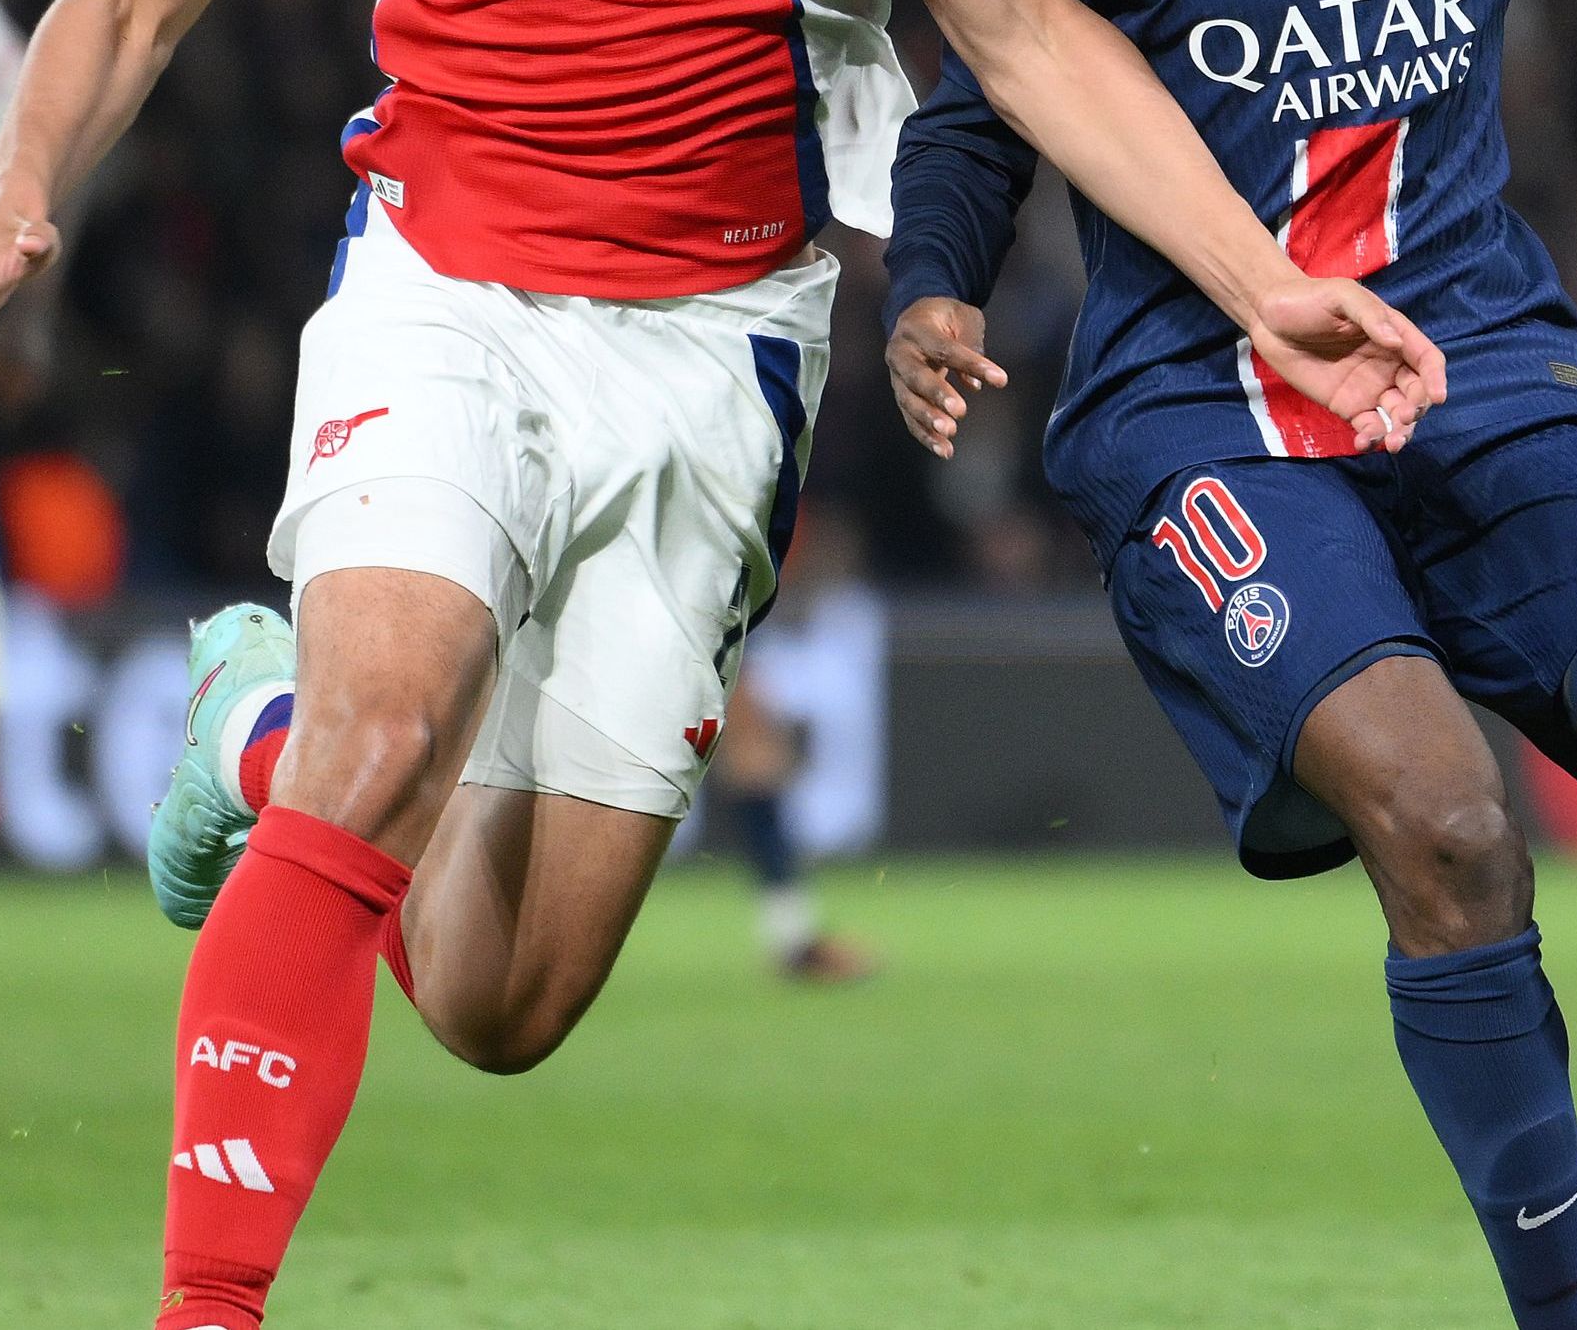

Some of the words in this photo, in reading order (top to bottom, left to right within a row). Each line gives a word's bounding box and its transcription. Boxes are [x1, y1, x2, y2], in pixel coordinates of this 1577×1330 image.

[1272, 42, 1473, 122] AIRWAYS
[724, 220, 785, 244] HEAT.RDY
[1152, 476, 1268, 613] 10
[1228, 587, 1260, 630] PARIS
[190, 1036, 297, 1089] AFC
